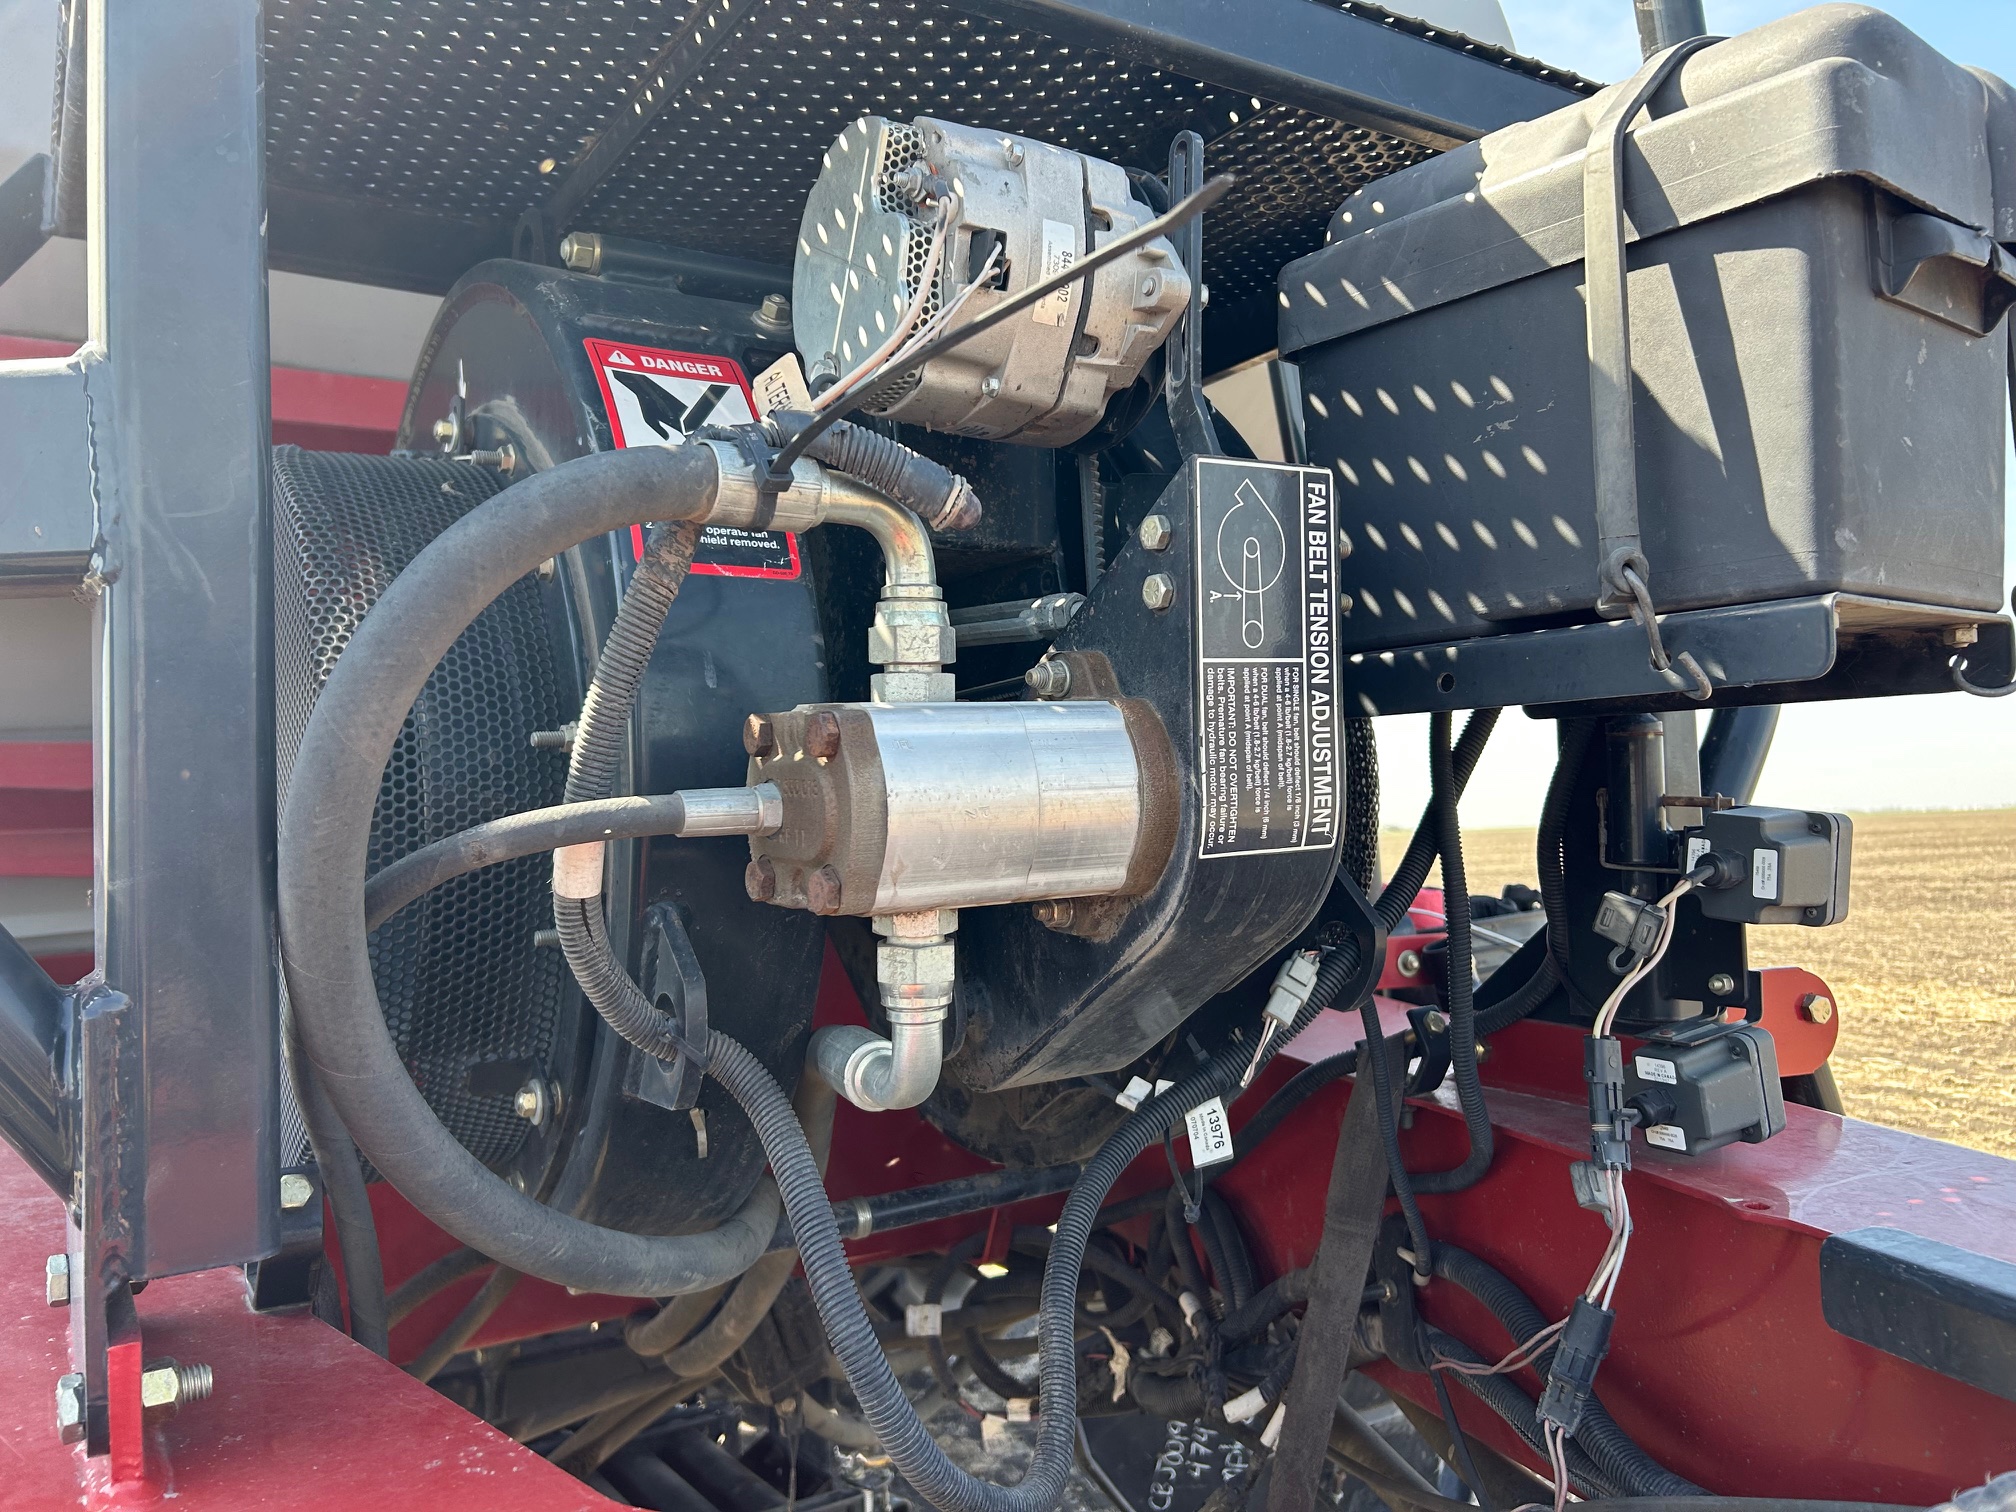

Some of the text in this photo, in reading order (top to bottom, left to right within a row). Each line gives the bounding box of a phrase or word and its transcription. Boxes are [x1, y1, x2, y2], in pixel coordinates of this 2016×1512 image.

[1056, 251, 1072, 303] 844902
[640, 355, 724, 377] DANGER
[700, 535, 780, 549] hield removed.
[706, 526, 748, 537] operate
[1209, 590, 1222, 604] A.
[1308, 482, 1332, 836] FAN BELT TENSION ADJUSTMENT
[1243, 667, 1251, 694] applied
[1252, 667, 1260, 687] when
[1275, 667, 1283, 694] applied
[1284, 667, 1292, 687] when
[1276, 694, 1283, 702] at
[1292, 684, 1300, 711] SINGLE
[1243, 704, 1252, 723] point
[1253, 707, 1261, 730] lb/belt
[1260, 706, 1269, 720] fan,
[1275, 703, 1284, 722] point
[1285, 706, 1293, 729] lb/belt
[1292, 713, 1300, 726] fan,
[1252, 731, 1261, 757] (1.8-2.7
[1284, 730, 1293, 756] (1.8-2.7
[1293, 727, 1301, 741] belt
[1216, 667, 1228, 844] belts. Premature fan bearing failure or
[1227, 667, 1238, 843] IMPORTANT: DO NOT OVERTIGHTEN
[1244, 730, 1253, 763] (midspan
[1262, 736, 1270, 761] should
[1275, 730, 1284, 762] (midspan
[1206, 667, 1218, 849] damage to hydraulic motor may occur.
[1246, 764, 1253, 773] of
[1277, 763, 1284, 771] of
[1253, 759, 1262, 786] kg/belt)
[1277, 772, 1285, 789] belt).
[1284, 757, 1294, 784] kg/belt)
[1245, 773, 1253, 791] belt).
[1254, 787, 1262, 805] force
[1286, 785, 1294, 803] force
[1294, 804, 1302, 819] inch
[1260, 824, 1268, 840] mm)
[1290, 828, 1299, 843] mm)
[1190, 1116, 1200, 1140] 070704
[1206, 1108, 1224, 1149] 13976
